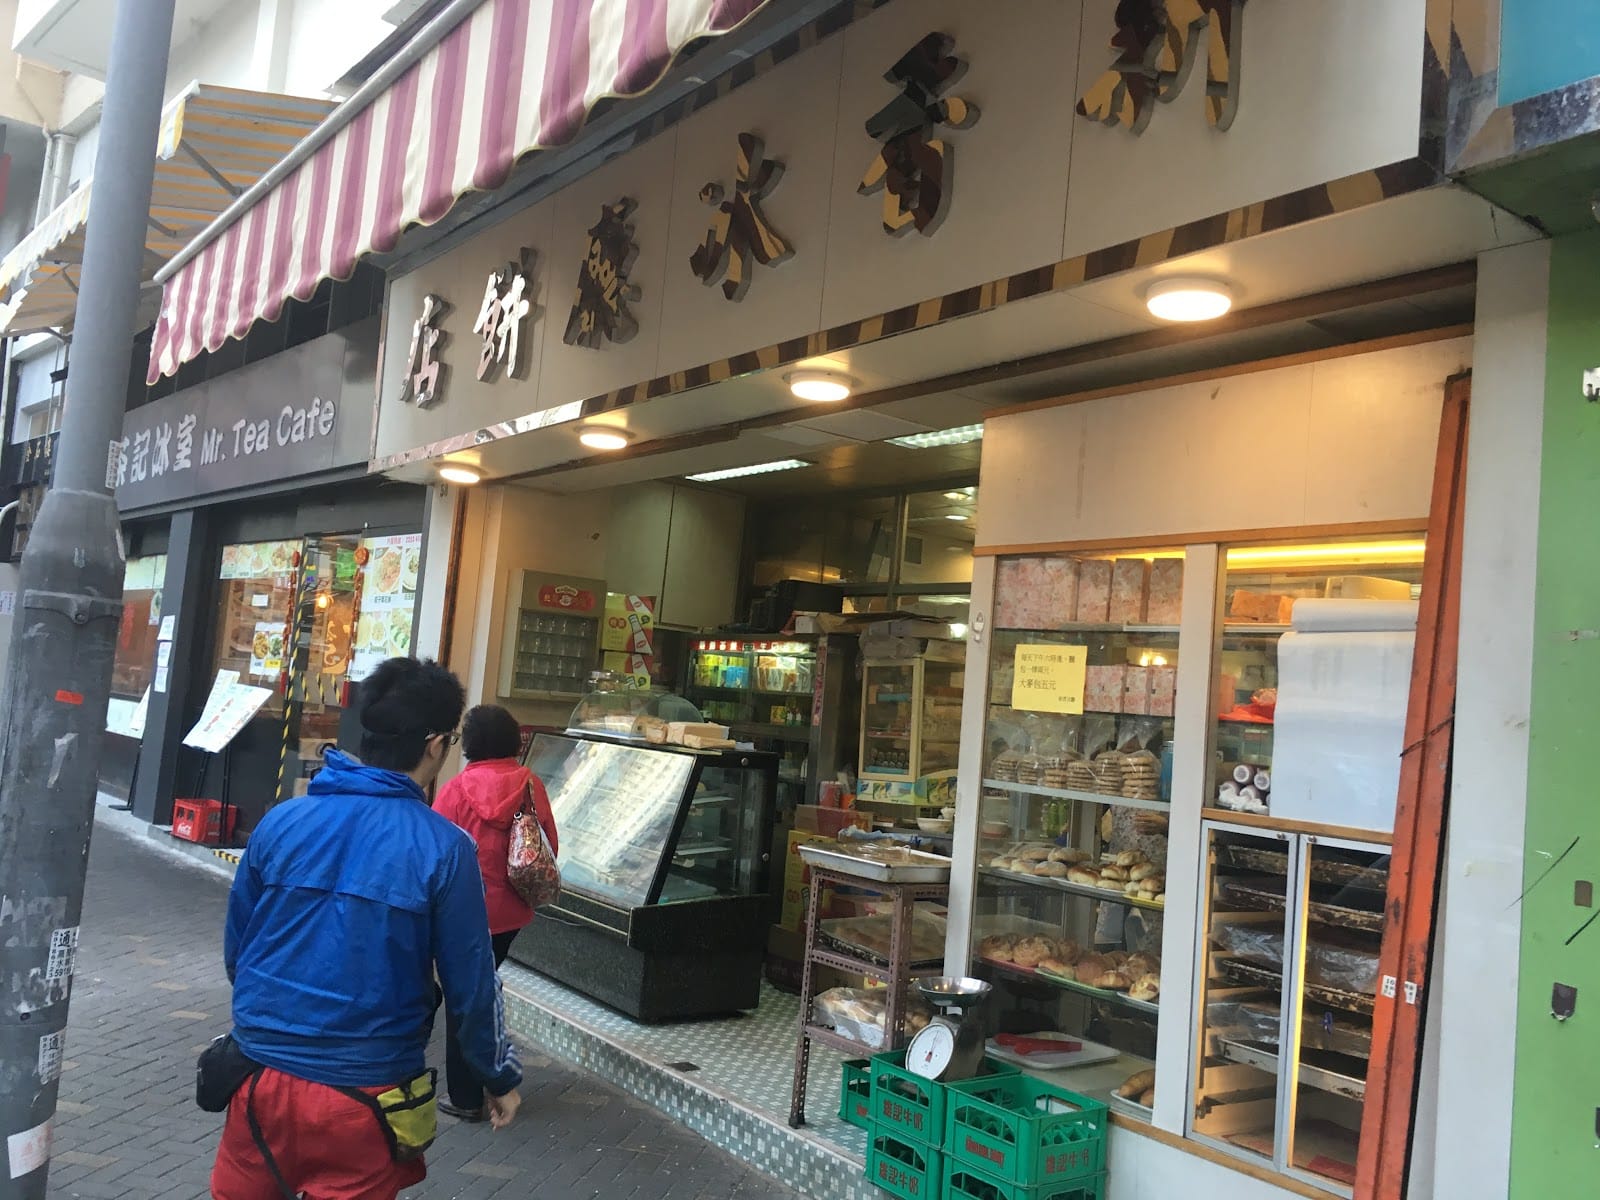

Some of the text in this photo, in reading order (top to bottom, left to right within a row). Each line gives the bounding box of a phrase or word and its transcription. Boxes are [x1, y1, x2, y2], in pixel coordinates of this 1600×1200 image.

[200, 397, 335, 466] Mr. Tea Cafe
